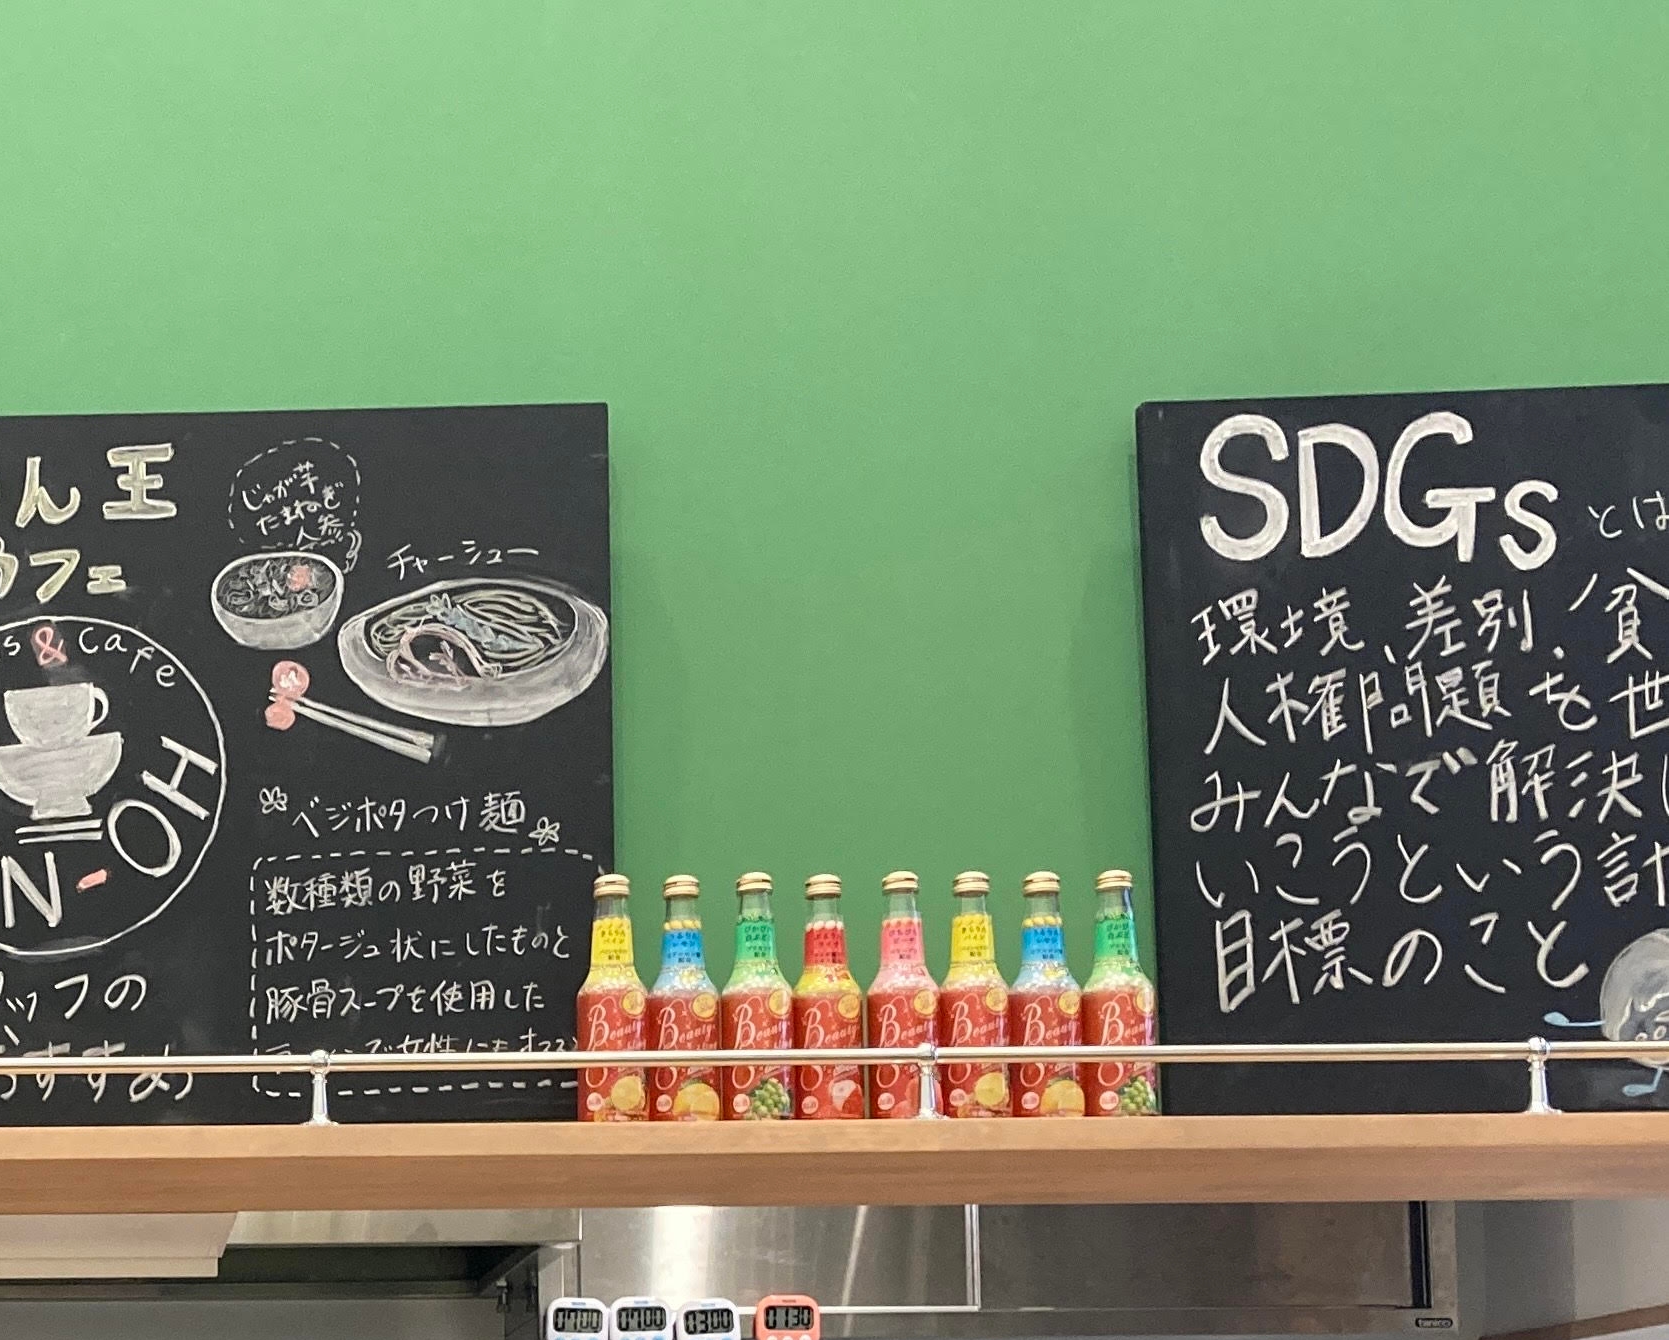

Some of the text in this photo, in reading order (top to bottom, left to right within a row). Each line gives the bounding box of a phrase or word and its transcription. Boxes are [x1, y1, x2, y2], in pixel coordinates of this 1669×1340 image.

[1199, 410, 1560, 572] SDGs
[386, 539, 540, 581] チャーシュー
[33, 624, 69, 668] &
[78, 626, 177, 689] Cafe
[290, 790, 528, 839] ベジポタつけ麺
[263, 859, 508, 915] 数種類の野菜を
[263, 923, 573, 968] ポタージュ状にしたものと
[1215, 908, 1590, 1013] 目標のこと
[263, 977, 547, 1027] 豚骨スープを使用した
